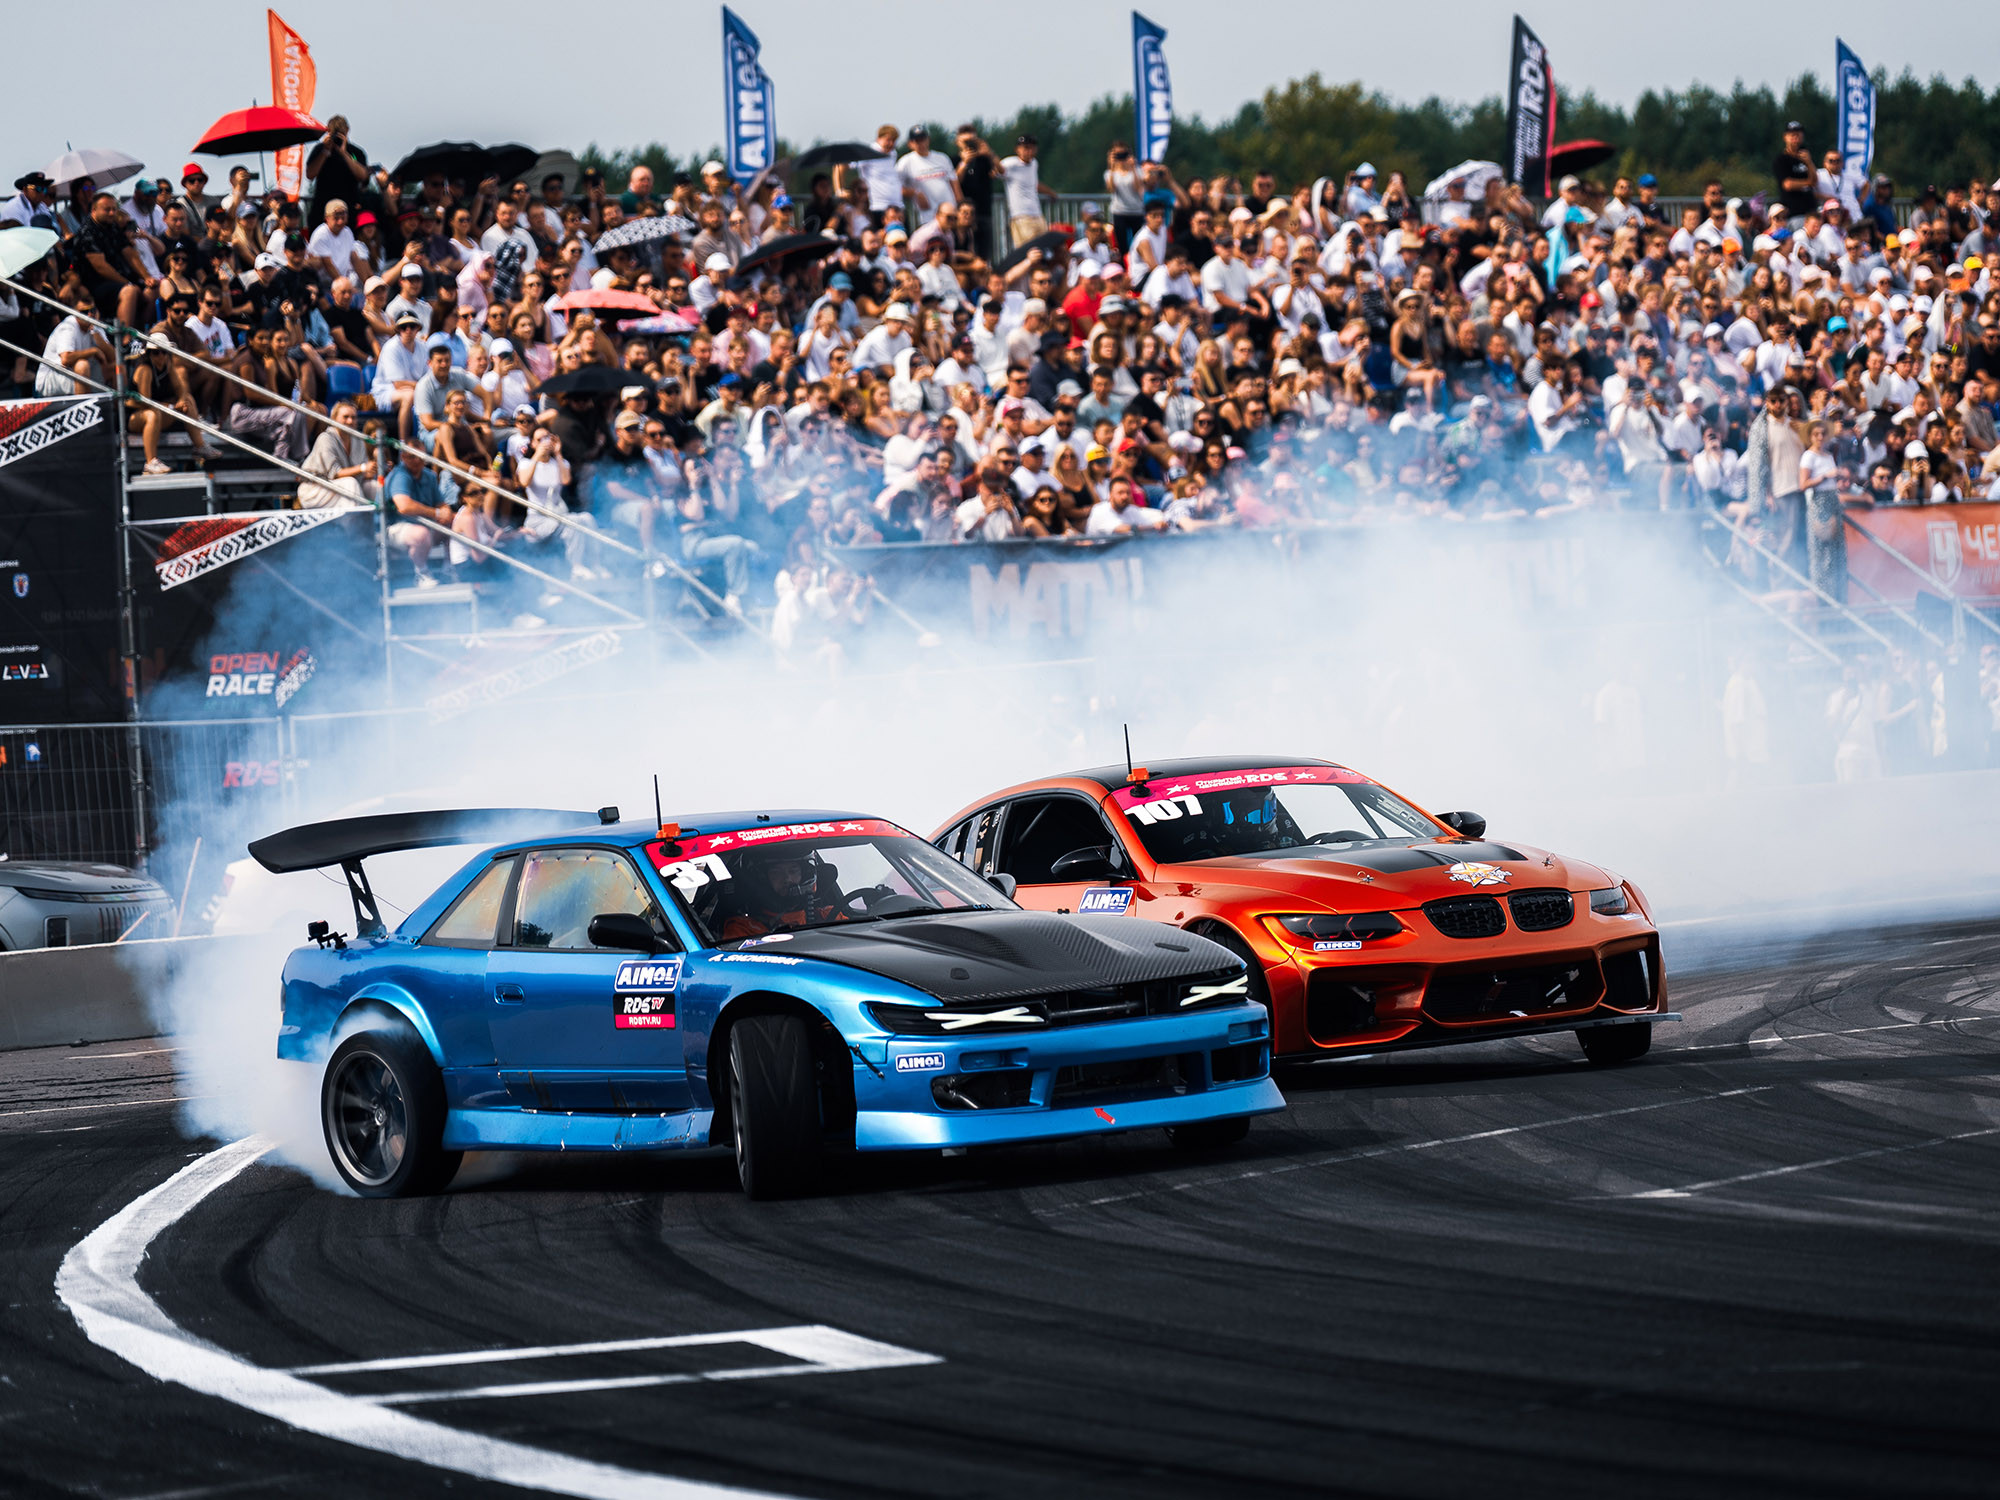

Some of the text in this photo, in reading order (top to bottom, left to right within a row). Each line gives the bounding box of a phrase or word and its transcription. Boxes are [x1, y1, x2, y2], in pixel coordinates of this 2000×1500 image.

[1964, 524, 2000, 561] ЧЕ
[210, 651, 280, 674] OPEN
[205, 673, 276, 697] RACE
[223, 761, 280, 787] RDS
[1244, 773, 1288, 783] RDS
[1123, 794, 1204, 826] 107
[788, 822, 835, 835] RDS
[1080, 893, 1127, 910] AIMOL
[1316, 942, 1360, 950] AIMOL
[617, 966, 676, 986] AIMOL
[628, 1016, 661, 1026] RDSTV.RU
[898, 1055, 943, 1069] AIMOL
